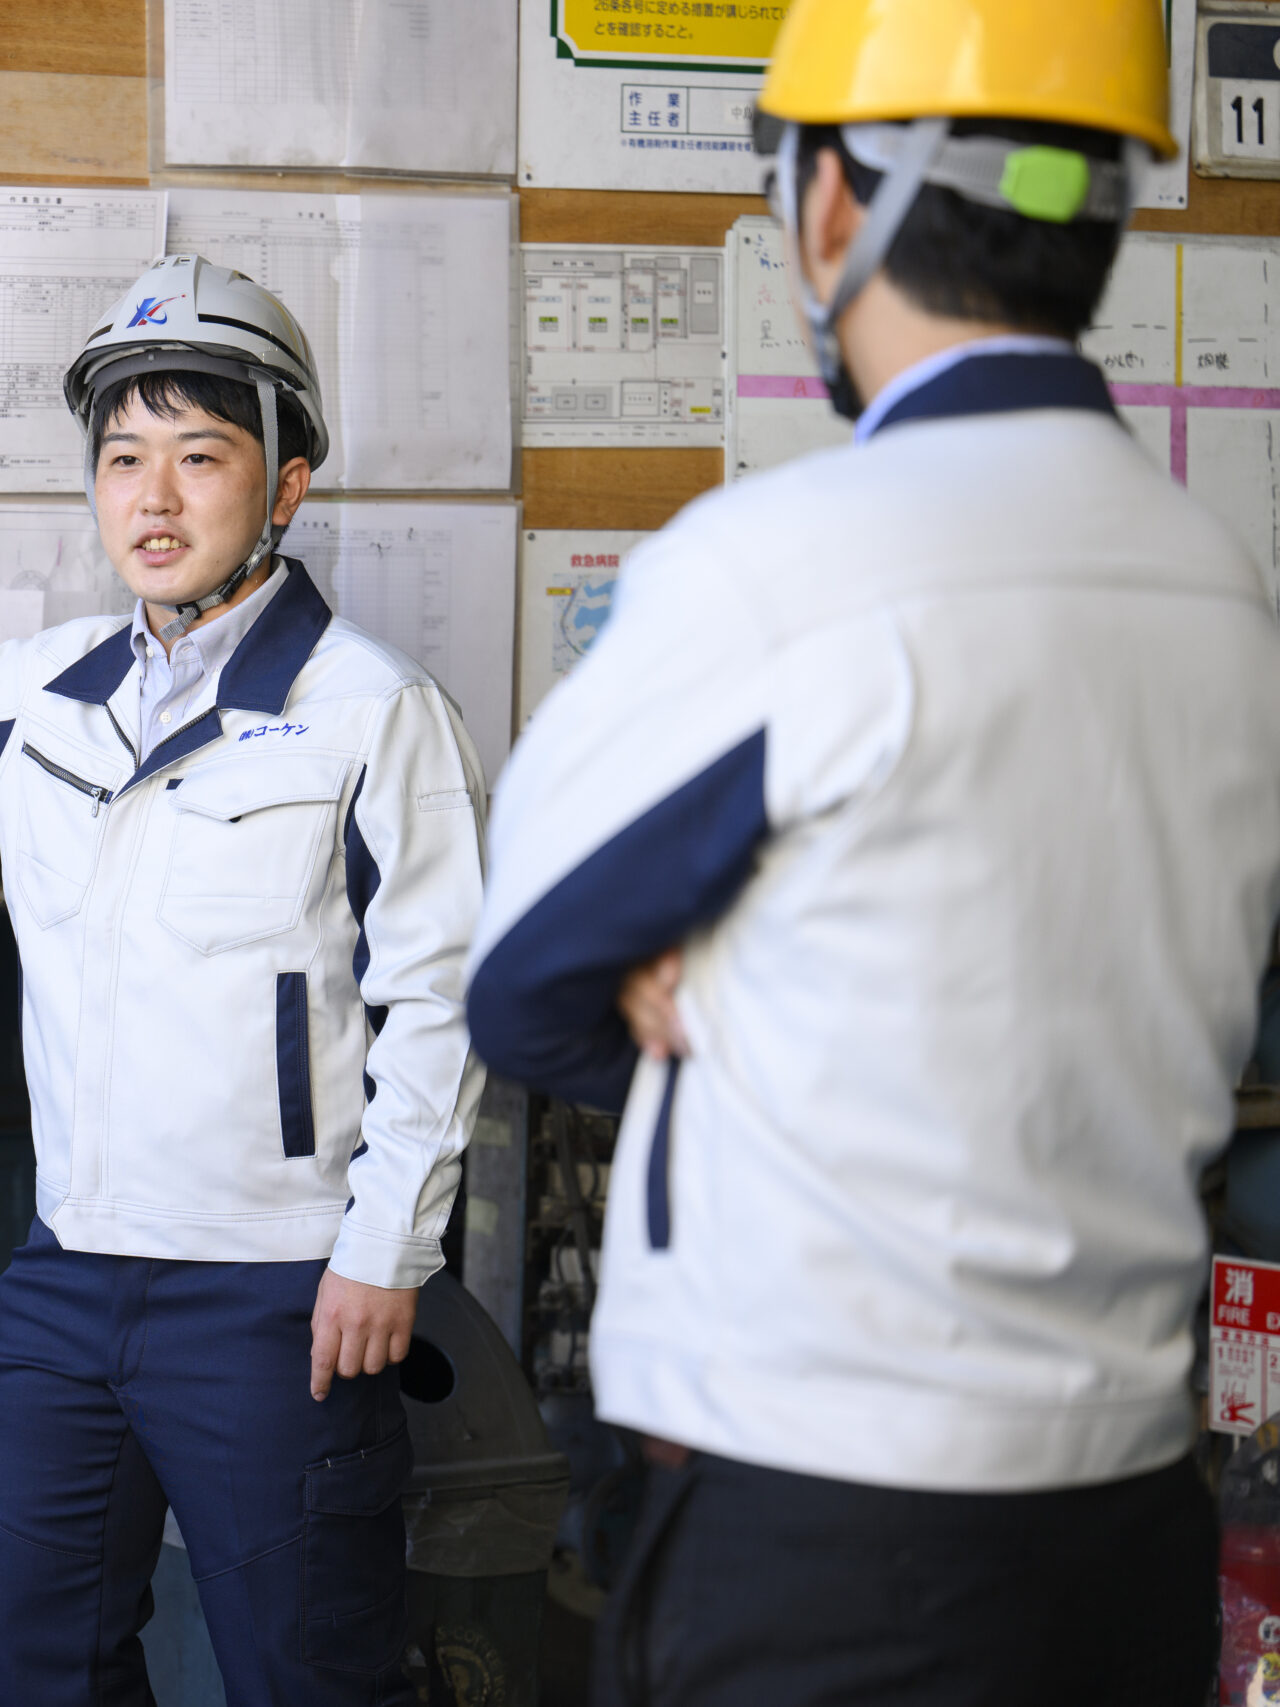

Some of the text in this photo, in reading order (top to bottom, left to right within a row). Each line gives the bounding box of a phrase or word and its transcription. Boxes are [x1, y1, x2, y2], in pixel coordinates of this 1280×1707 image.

[628, 91, 680, 107] 作業
[628, 110, 680, 127] 主任者
[1231, 96, 1264, 145] 11
[571, 554, 619, 568] 救急病院
[1225, 1267, 1254, 1306] 消
[1218, 1304, 1251, 1327] FIRE
